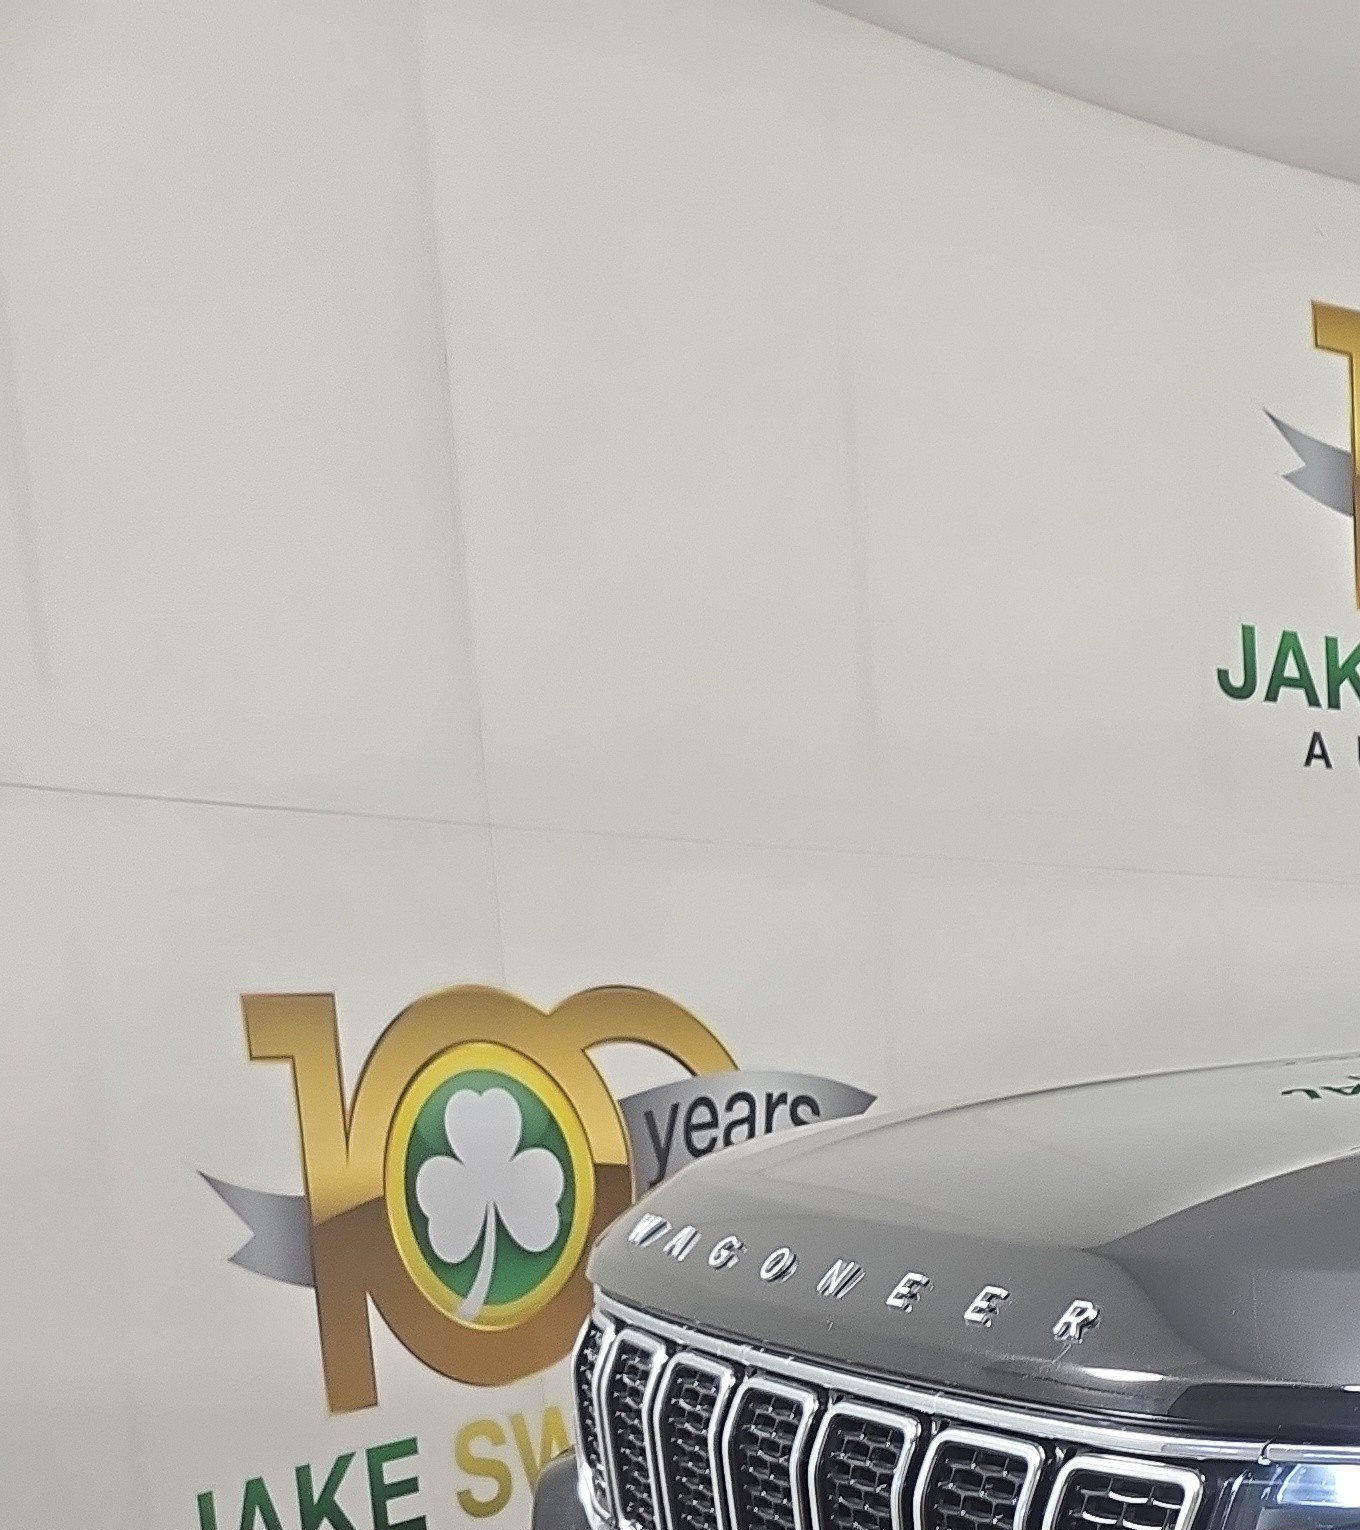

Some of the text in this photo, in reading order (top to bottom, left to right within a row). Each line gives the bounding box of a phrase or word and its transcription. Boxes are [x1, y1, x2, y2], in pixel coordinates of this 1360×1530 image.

[643, 1090, 821, 1188] years
[628, 1212, 1102, 1343] WAGONEER
[453, 1404, 576, 1518] SW
